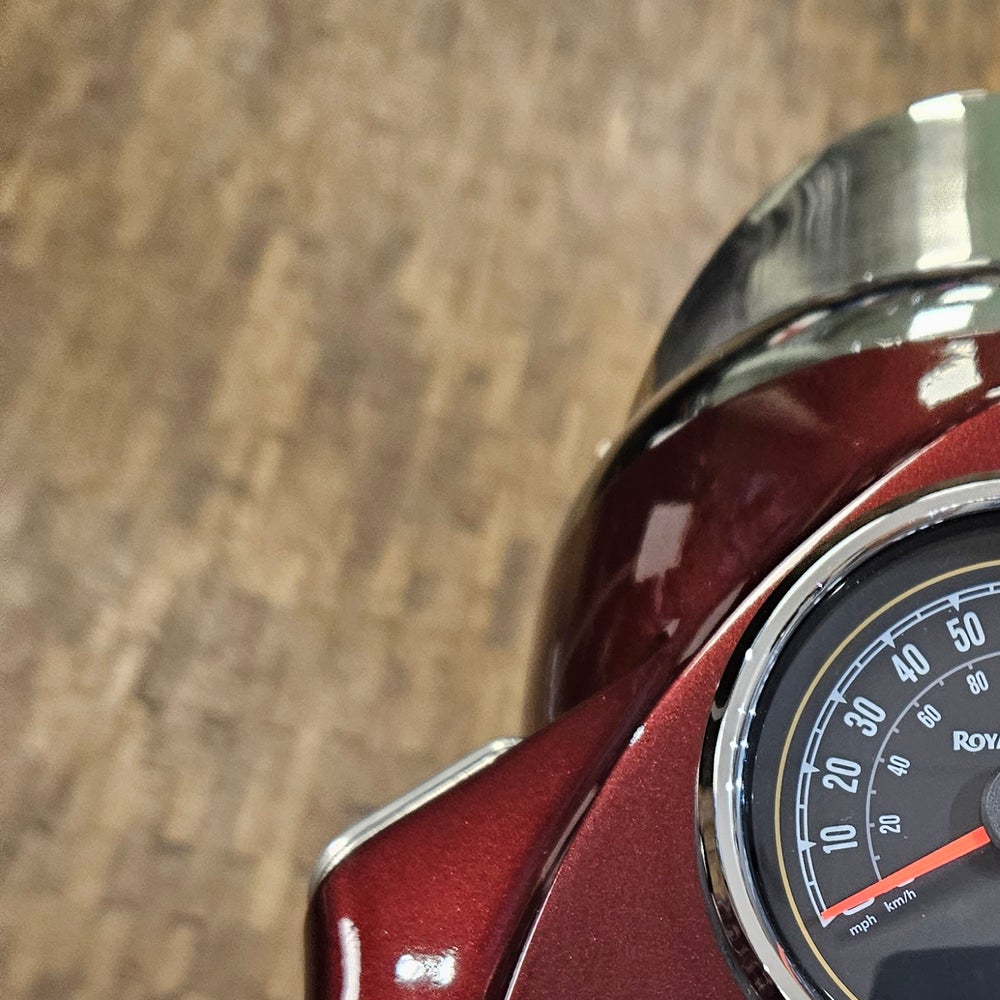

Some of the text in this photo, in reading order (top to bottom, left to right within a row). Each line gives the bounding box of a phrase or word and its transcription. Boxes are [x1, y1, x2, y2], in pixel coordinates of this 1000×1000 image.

[946, 611, 985, 653] 50
[890, 643, 930, 684] 40
[966, 670, 989, 695] 80
[844, 696, 886, 737] 30
[917, 704, 942, 729] 60
[822, 757, 861, 793] 20
[887, 754, 911, 777] 40
[879, 814, 901, 835] 20
[820, 824, 858, 854] 10
[883, 889, 917, 912] km/h
[849, 914, 878, 936] mph
